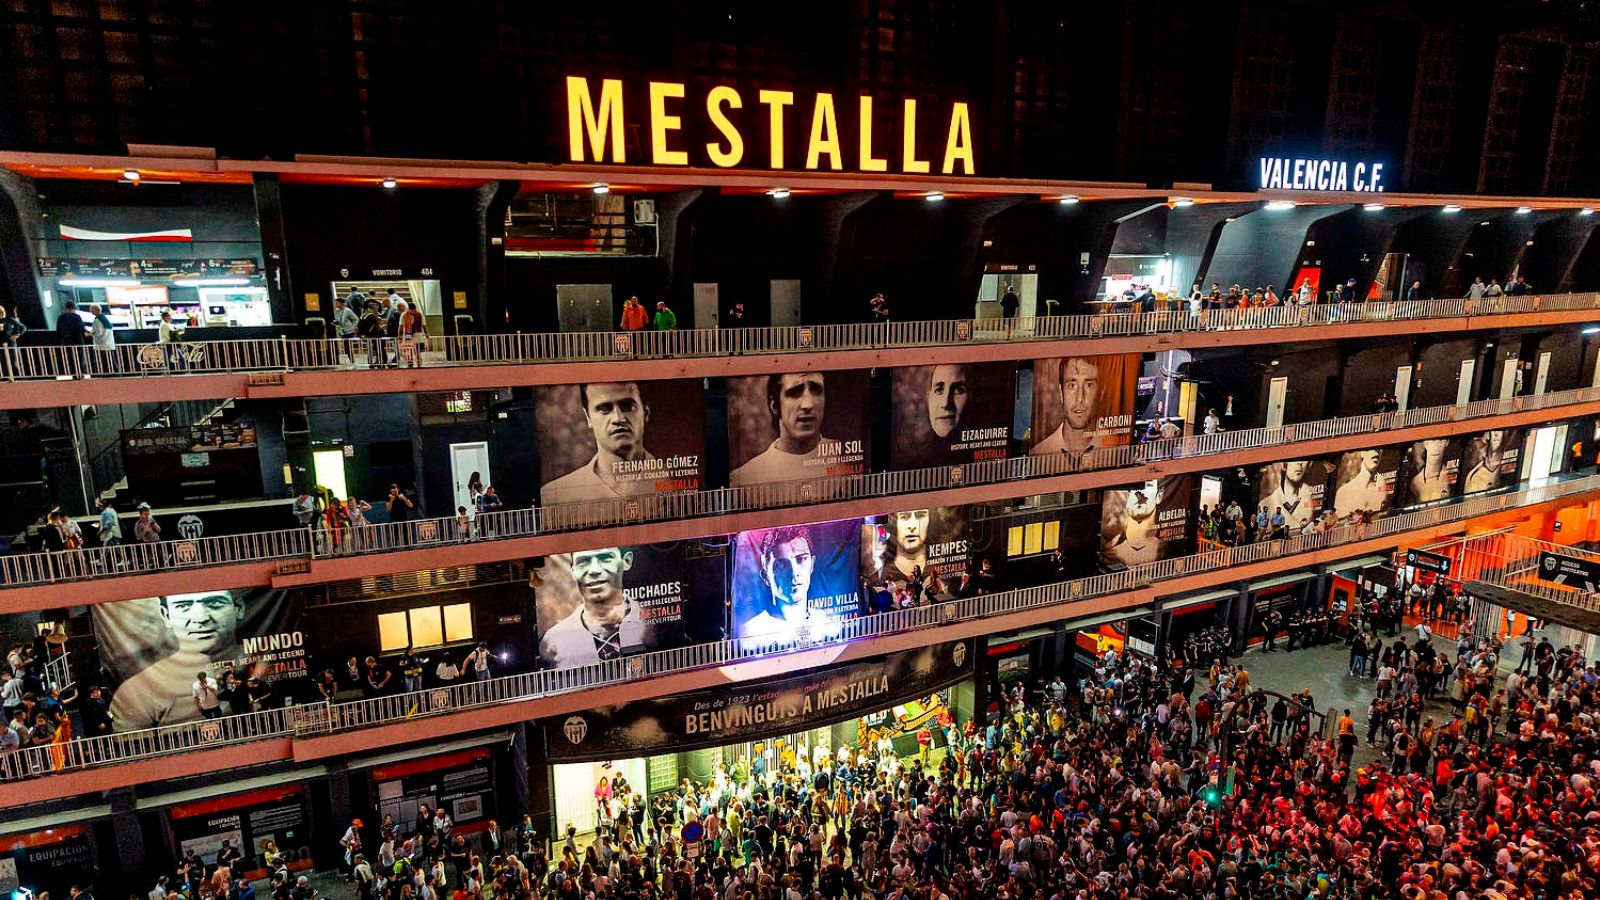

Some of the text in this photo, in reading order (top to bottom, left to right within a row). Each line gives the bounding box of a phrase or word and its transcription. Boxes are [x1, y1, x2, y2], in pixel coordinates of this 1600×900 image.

[566, 76, 975, 175] MESTALLA
[1261, 157, 1384, 192] VALENCIA C.F.
[1098, 415, 1132, 429] CARBONI
[961, 427, 1008, 442] EIZAGUIRRE
[817, 440, 864, 457] JUAN SOL
[612, 455, 699, 473] FERNANDO GÓMEZ
[1158, 508, 1186, 521] ALBELDA
[929, 540, 967, 557] KEMPES
[808, 592, 859, 608] DAVID VILLA
[640, 604, 682, 619] MESTALLA
[242, 631, 304, 654] MUNDO
[239, 655, 260, 666] HEART
[263, 653, 277, 662] AND
[278, 649, 305, 660] LEGEND
[685, 700, 797, 734] BENVINGUTS
[803, 695, 812, 715] A
[817, 674, 889, 710] MESTALLA
[694, 702, 711, 711] Des
[712, 700, 724, 708] de
[728, 695, 750, 706] 1923
